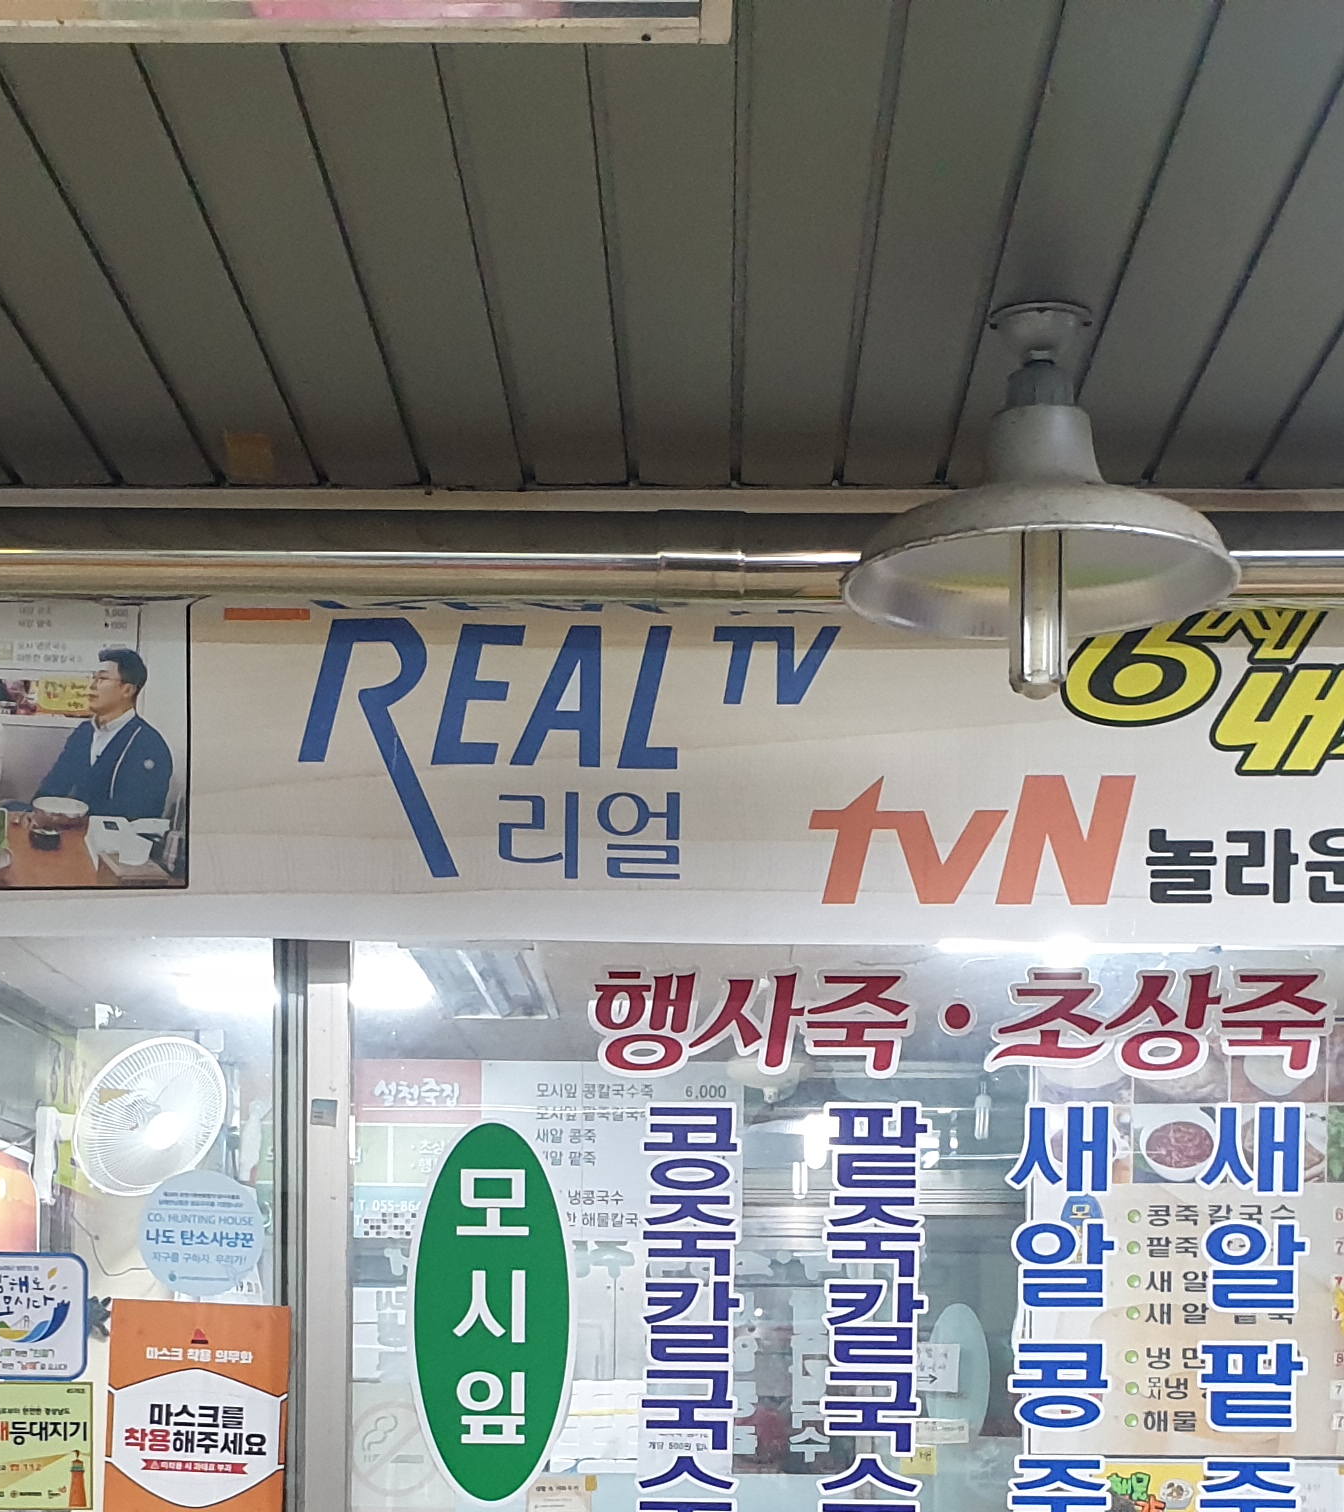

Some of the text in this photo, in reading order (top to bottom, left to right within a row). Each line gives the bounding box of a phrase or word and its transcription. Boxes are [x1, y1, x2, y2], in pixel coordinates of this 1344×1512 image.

[297, 615, 841, 878] REAL TV
[497, 791, 682, 881] 리얼
[808, 773, 1138, 906] tvN
[536, 1083, 578, 1099] 모시잎
[685, 1085, 727, 1100] 6,000
[568, 1128, 597, 1144] 콩죽
[168, 1214, 216, 1225] HUNTING
[218, 1215, 255, 1226] HOUSE
[581, 1212, 642, 1228] 해물칼국
[146, 1228, 255, 1249] 나도 탄소사냥꾼
[452, 1167, 531, 1446] 모시잎
[146, 1346, 254, 1364] 마스크 착용 의무화
[149, 1402, 245, 1430] 마스크를
[124, 1427, 267, 1456] 착용해주세요
